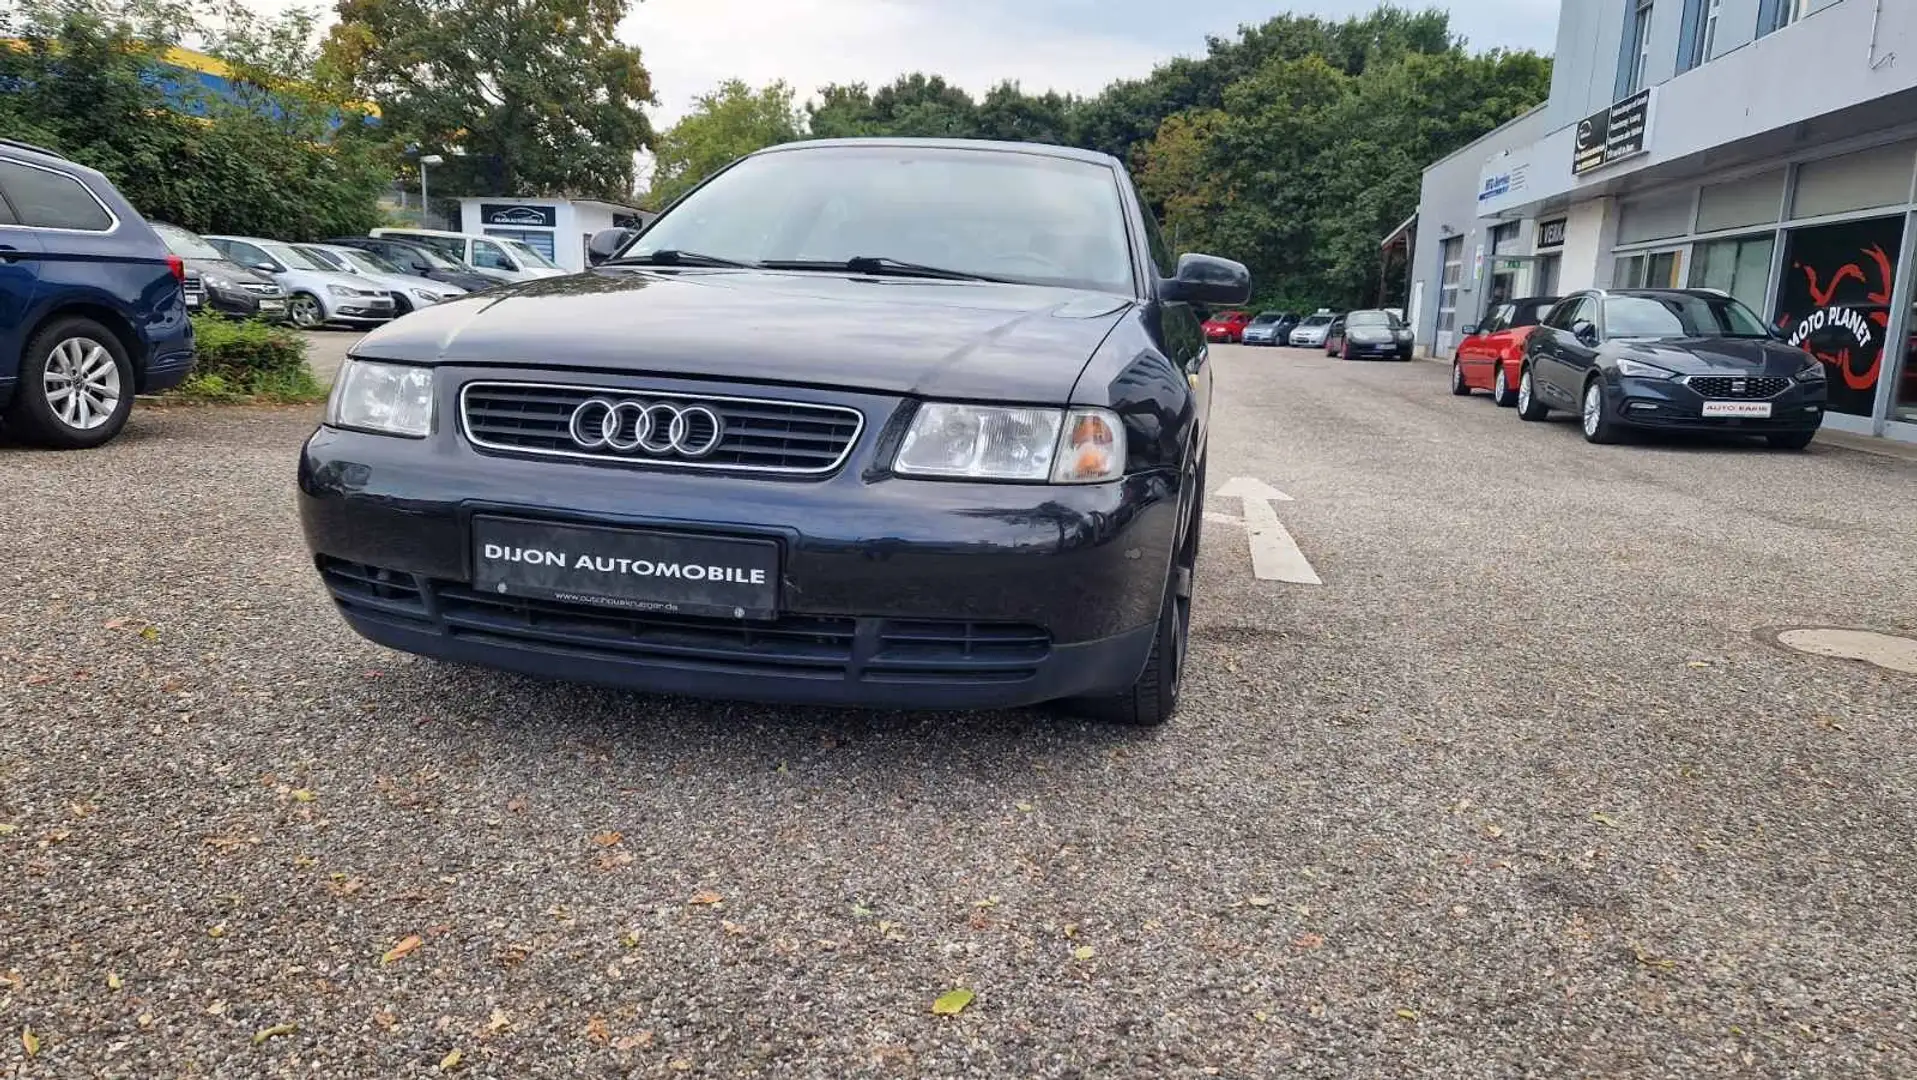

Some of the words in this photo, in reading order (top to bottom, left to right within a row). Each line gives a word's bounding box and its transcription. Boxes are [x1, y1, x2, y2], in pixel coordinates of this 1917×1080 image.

[1788, 310, 1825, 347] MOTO
[1828, 306, 1872, 348] PLANET
[1706, 404, 1736, 412] AUTO
[484, 543, 566, 567] DIJON
[573, 553, 766, 584] AUTOMOBILE
